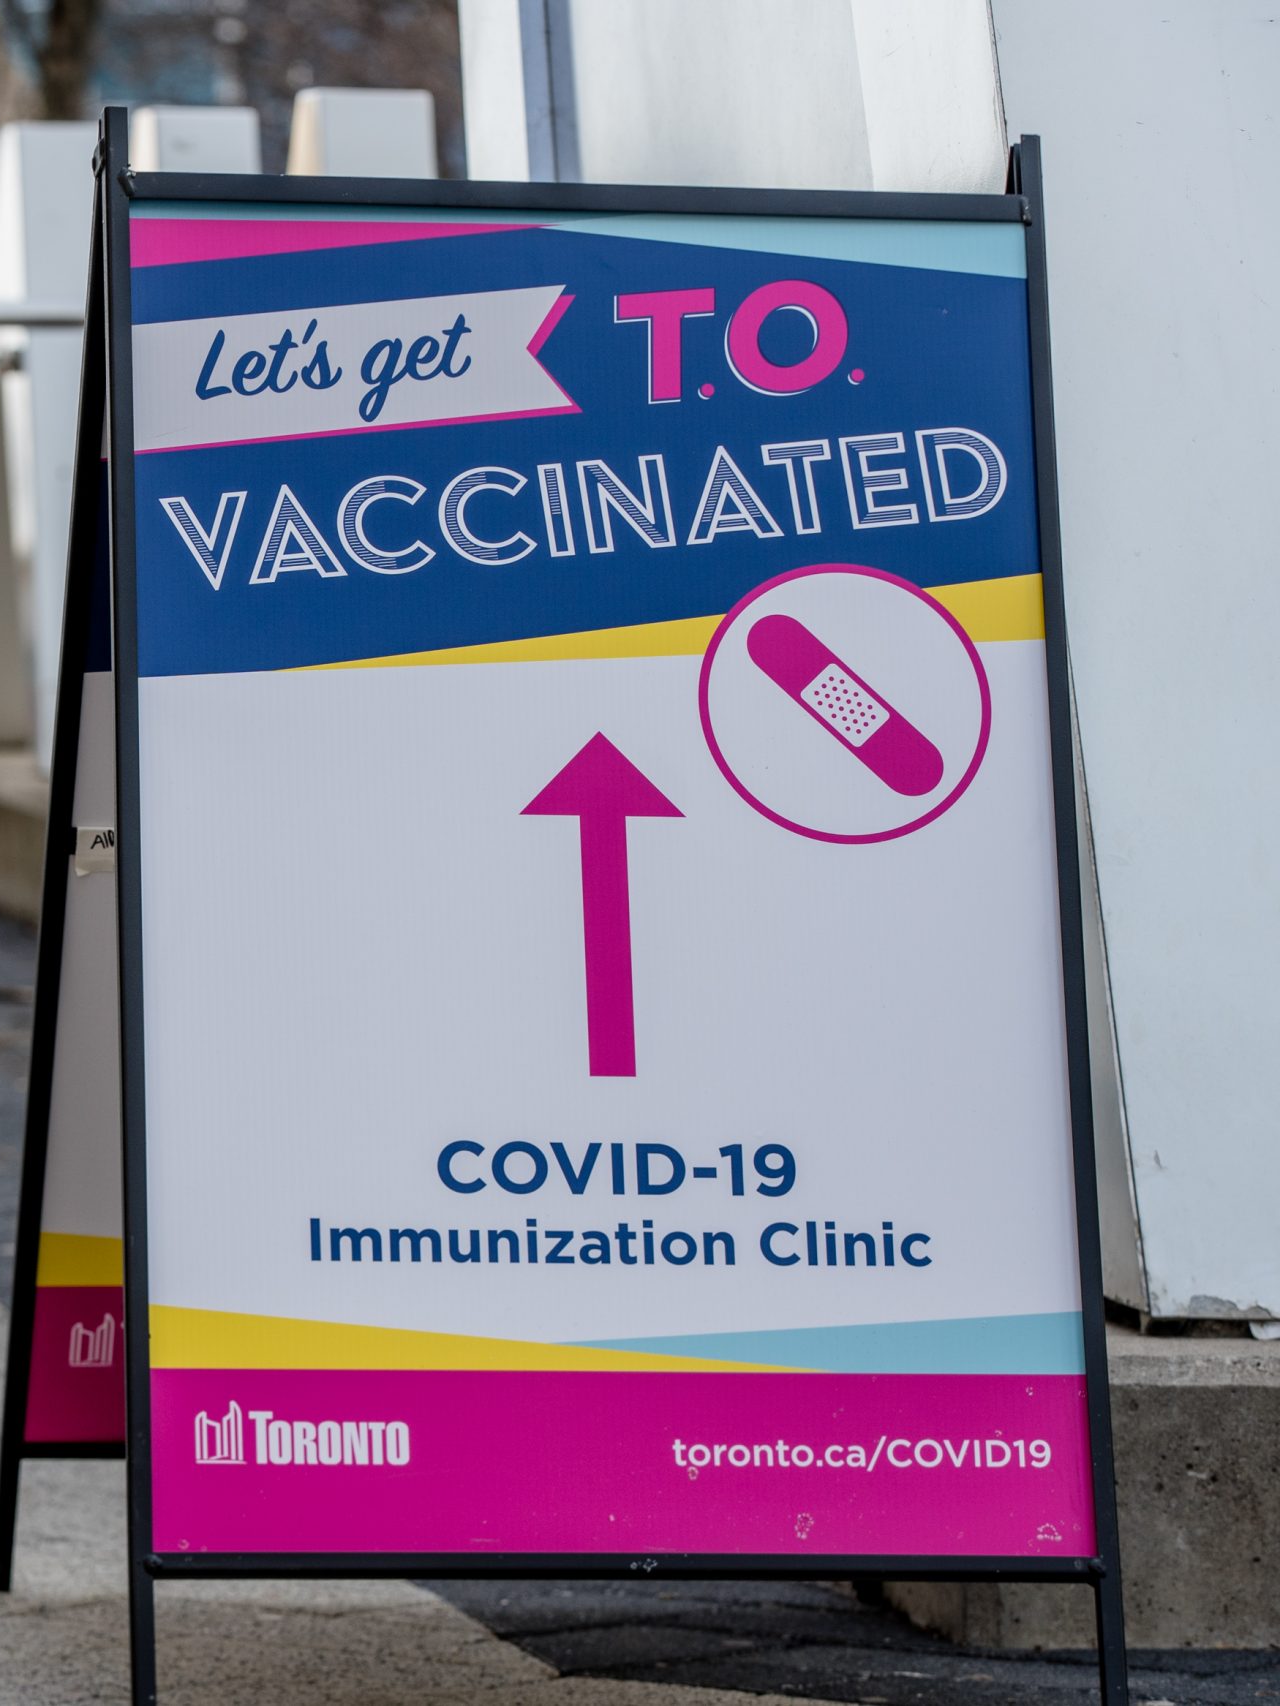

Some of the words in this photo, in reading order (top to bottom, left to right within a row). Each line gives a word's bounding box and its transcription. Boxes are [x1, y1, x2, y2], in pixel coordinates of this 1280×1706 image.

[195, 317, 341, 401] Let's
[359, 313, 473, 425] get
[614, 280, 867, 405] T.O.
[158, 426, 1011, 591] VACCINATED
[436, 1139, 797, 1198] COVID-19
[309, 1217, 736, 1266] Immunization
[759, 1219, 933, 1268] Clinic
[248, 1411, 410, 1466] TORONTO
[672, 1434, 1052, 1474] toronto.ca/COVID19
